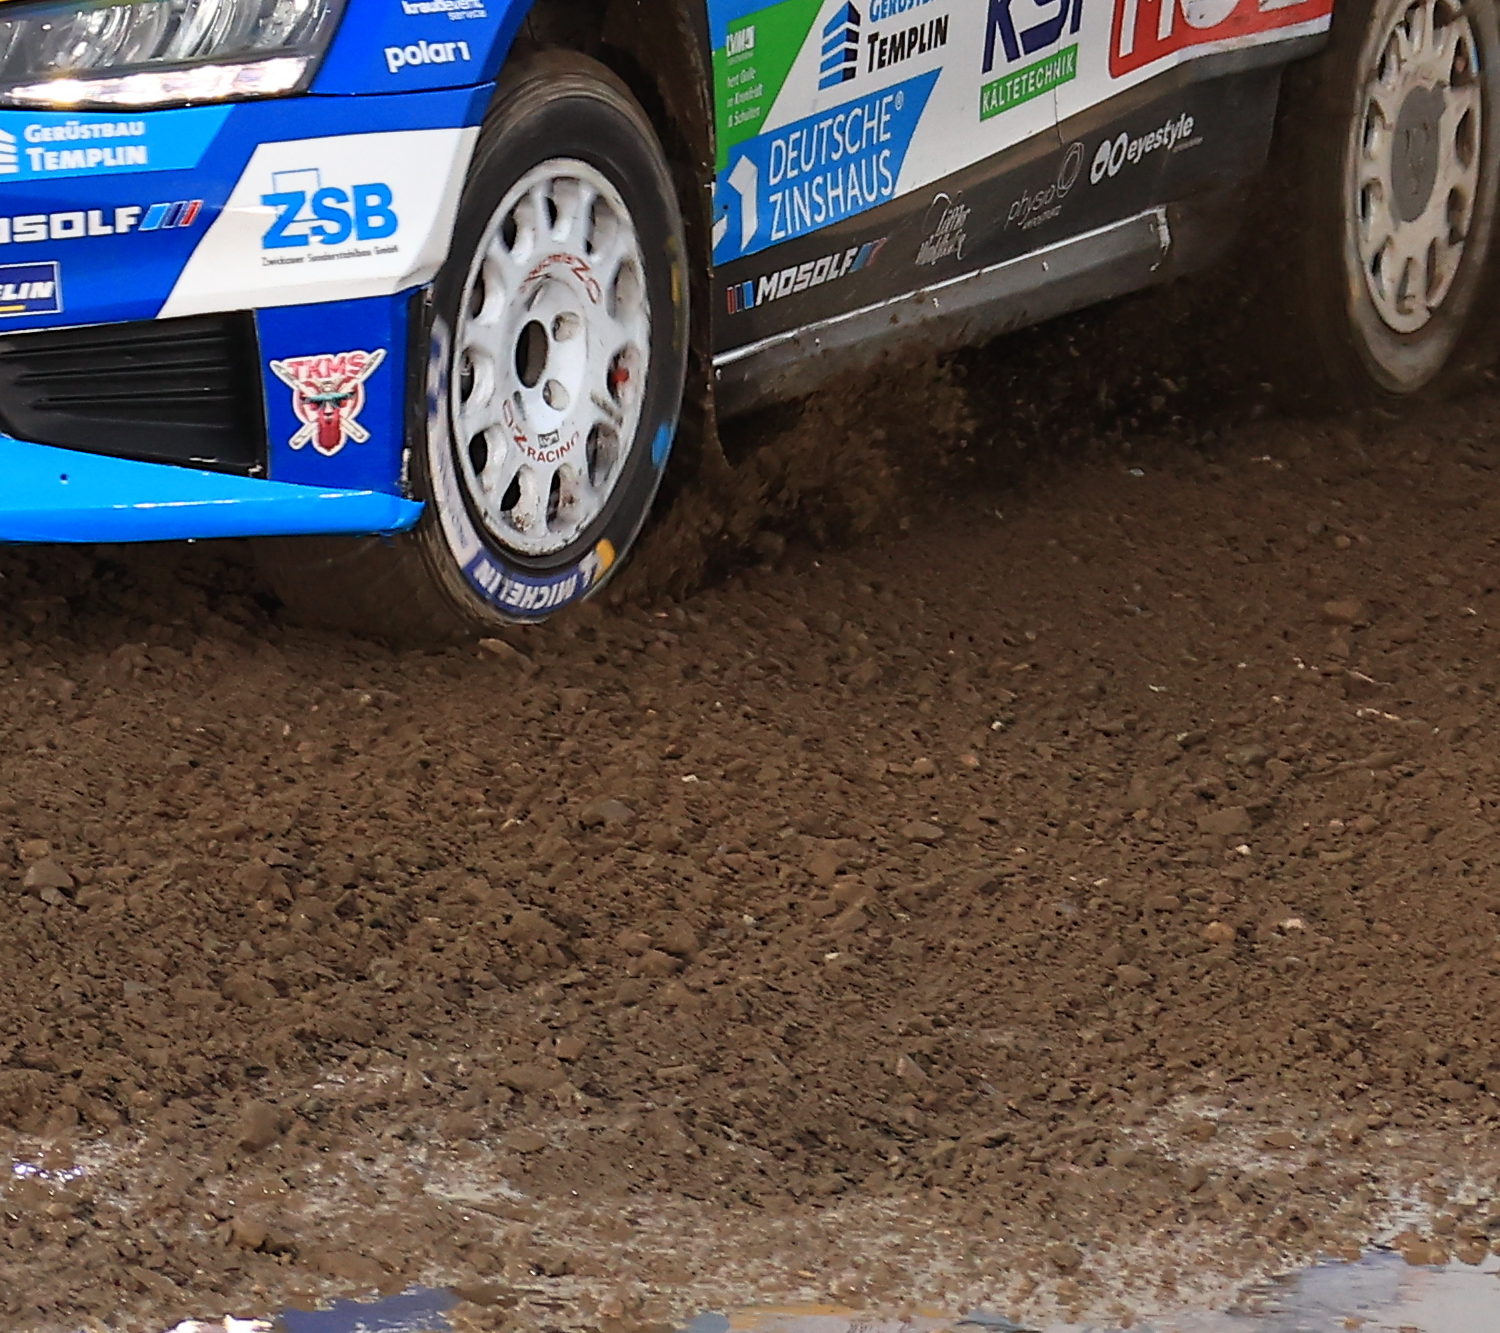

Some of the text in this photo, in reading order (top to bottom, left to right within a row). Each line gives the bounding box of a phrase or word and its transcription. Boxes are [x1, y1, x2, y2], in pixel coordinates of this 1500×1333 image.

[384, 39, 471, 74] polar1
[867, 15, 950, 74] TEMPLIN
[981, 52, 1075, 114] KÄLTETECHNIK
[24, 145, 147, 172] TEMPLIN
[770, 98, 892, 186] DEUTSCHE
[1127, 113, 1195, 164] eyestyle
[260, 182, 398, 250] ZSB
[769, 150, 895, 241] ZINSHAUS
[756, 247, 856, 306] MOSOLF
[289, 354, 366, 379] TKMS
[473, 558, 578, 610] MICHELIN
